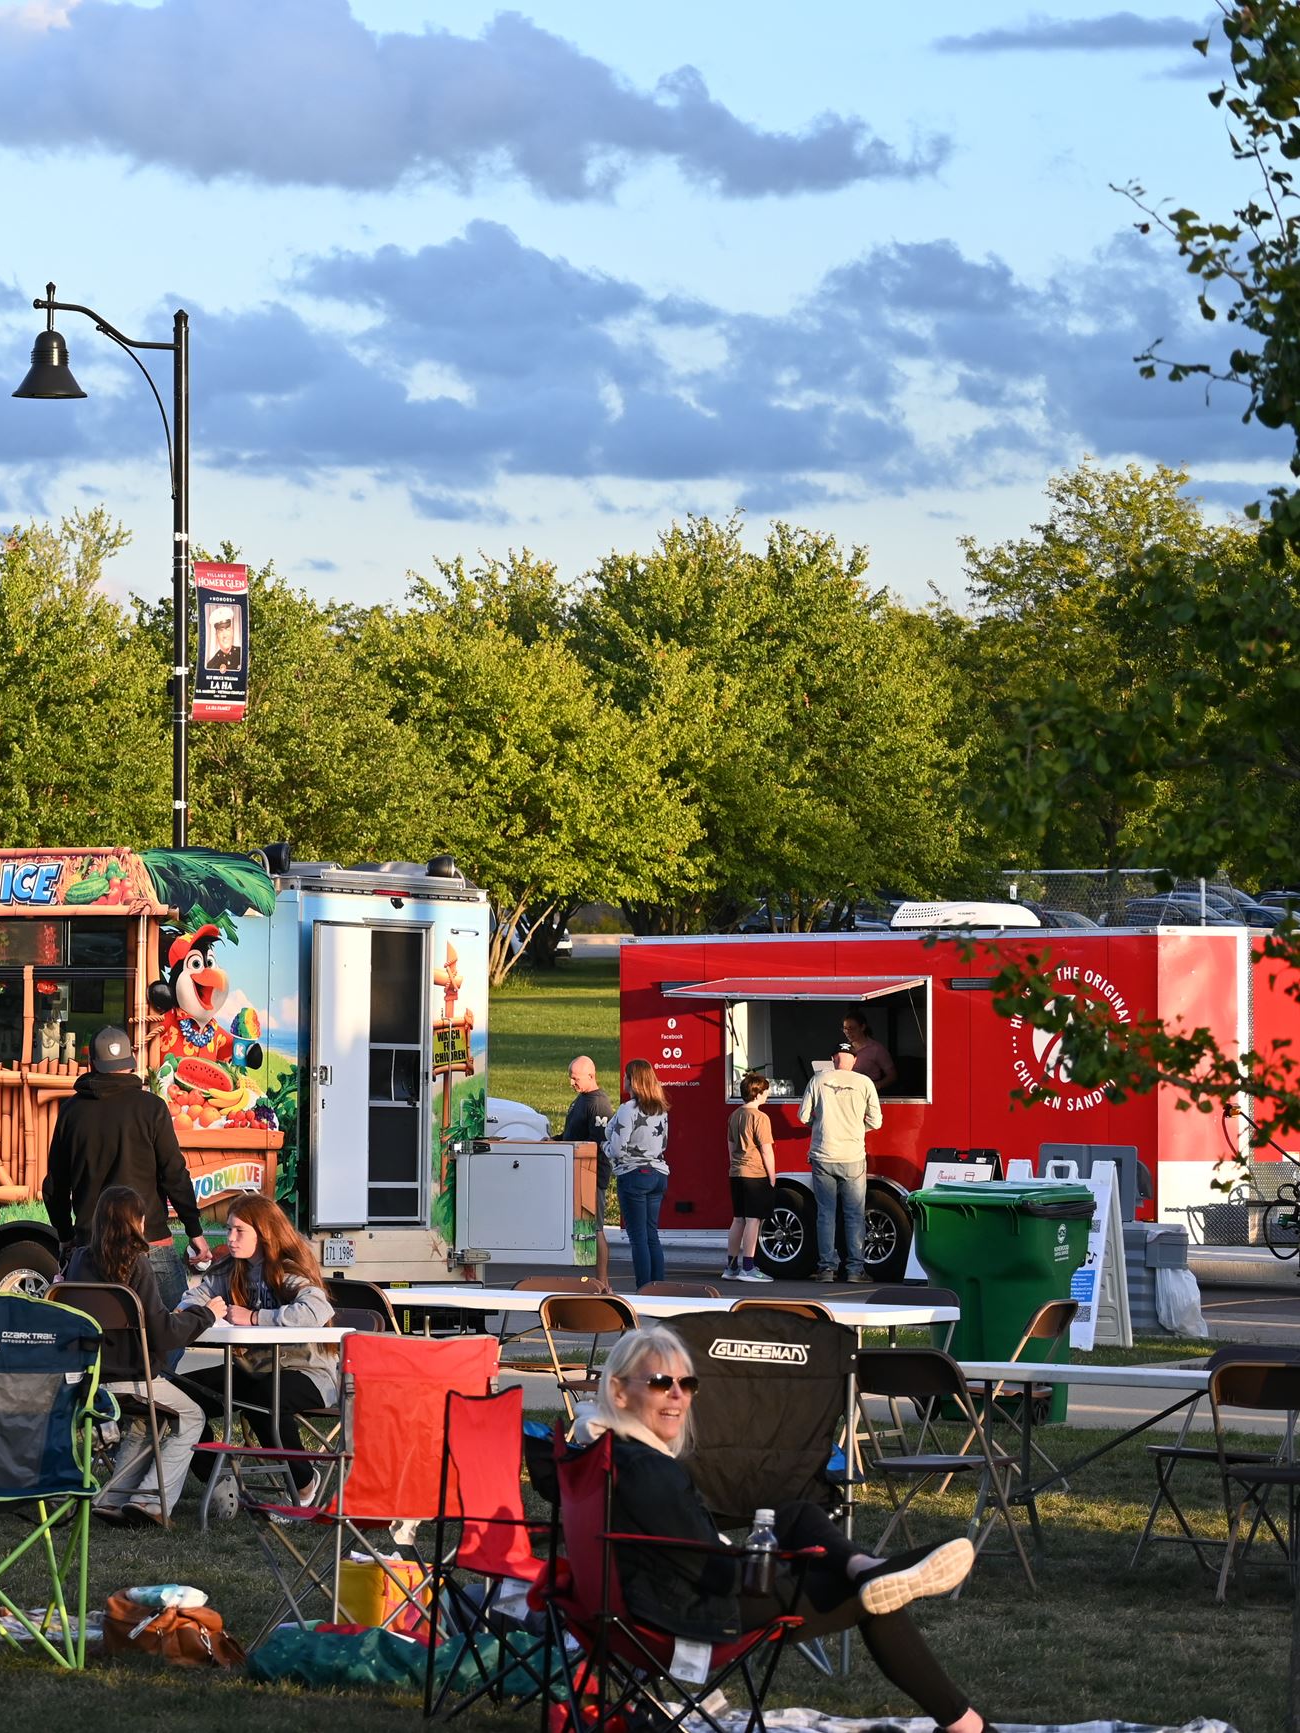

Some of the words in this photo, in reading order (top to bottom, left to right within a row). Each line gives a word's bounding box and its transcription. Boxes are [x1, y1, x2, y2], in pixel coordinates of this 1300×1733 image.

[198, 577, 225, 587] HOMER
[225, 580, 245, 589] GLEN
[210, 681, 220, 690] LA
[221, 681, 232, 690] HA
[1056, 967, 1079, 981] THE
[437, 1030, 460, 1042] WATCH
[444, 1041, 456, 1052] FOR
[435, 1050, 466, 1063] CHILDREN
[1013, 1060, 1061, 1110] CHICEN
[194, 1166, 260, 1198] VORWAVE
[326, 1247, 336, 1260] 171
[2, 1331, 32, 1339] OZARK
[714, 1343, 802, 1360] GUIDESMAN
